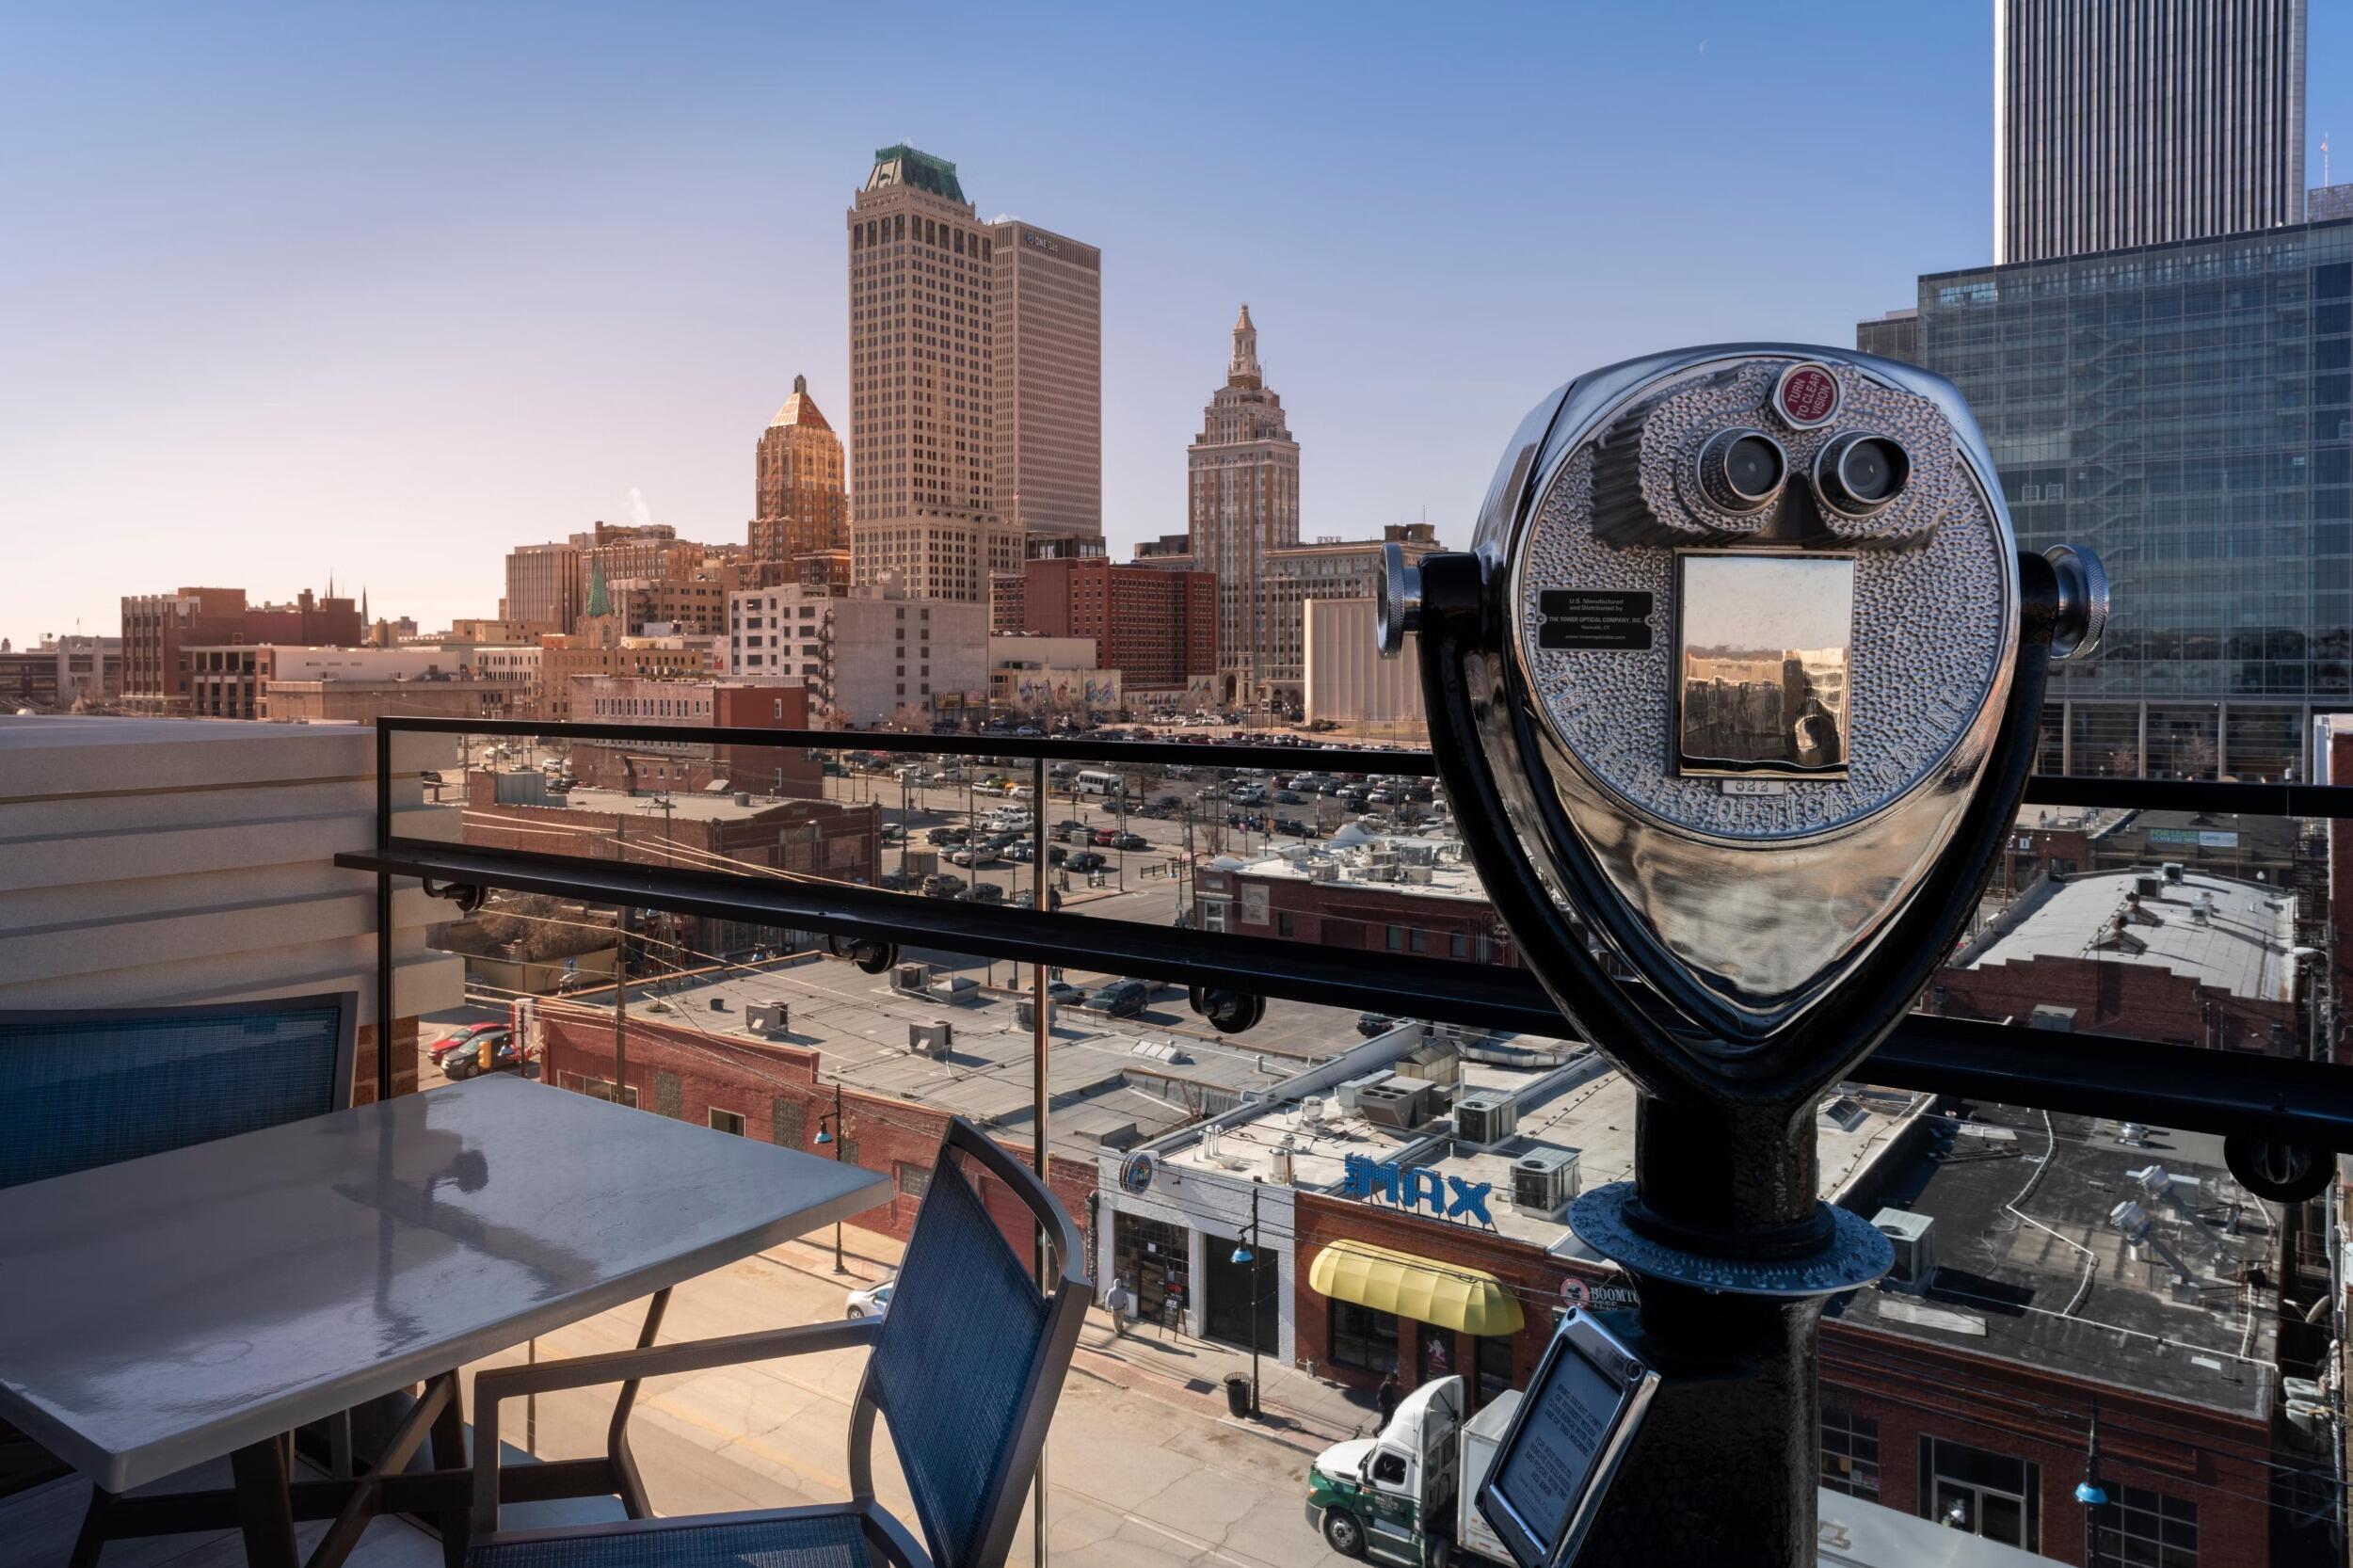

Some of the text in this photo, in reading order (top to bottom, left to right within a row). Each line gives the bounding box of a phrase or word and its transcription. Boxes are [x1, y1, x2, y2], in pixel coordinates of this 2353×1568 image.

[1787, 378, 1806, 403] TURN
[1796, 373, 1821, 417] TO CLEAR
[1811, 384, 1831, 414] VISION
[1596, 735, 1705, 823] TOWER
[1716, 783, 1871, 826] OPTICAL
[1875, 744, 1921, 785] CO
[1921, 684, 1968, 742] INC
[1345, 1152, 1492, 1224] MAX
